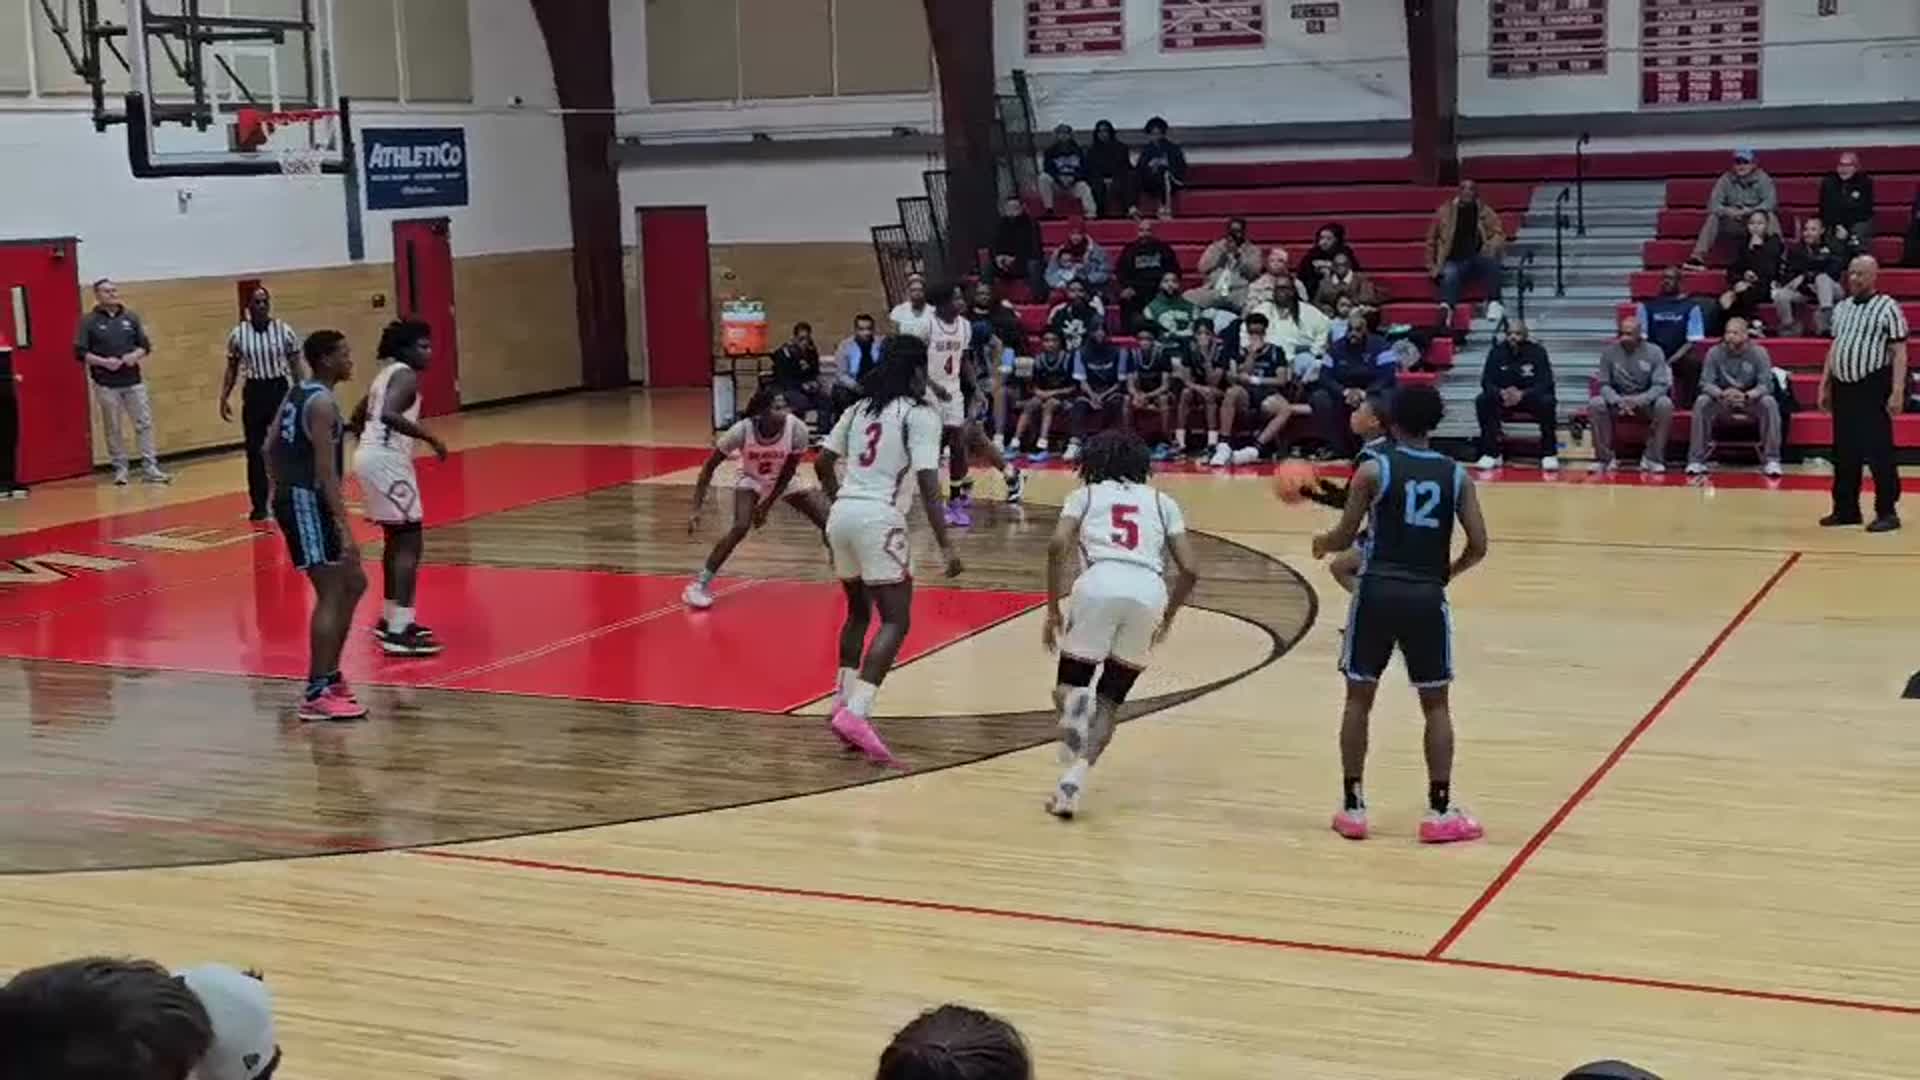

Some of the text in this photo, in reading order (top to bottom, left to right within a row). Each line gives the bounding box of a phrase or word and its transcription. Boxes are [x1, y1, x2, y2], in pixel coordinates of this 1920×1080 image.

[943, 354, 954, 375] 4
[859, 422, 882, 467] 3
[1111, 503, 1139, 551] 5
[1404, 479, 1441, 529] 12
